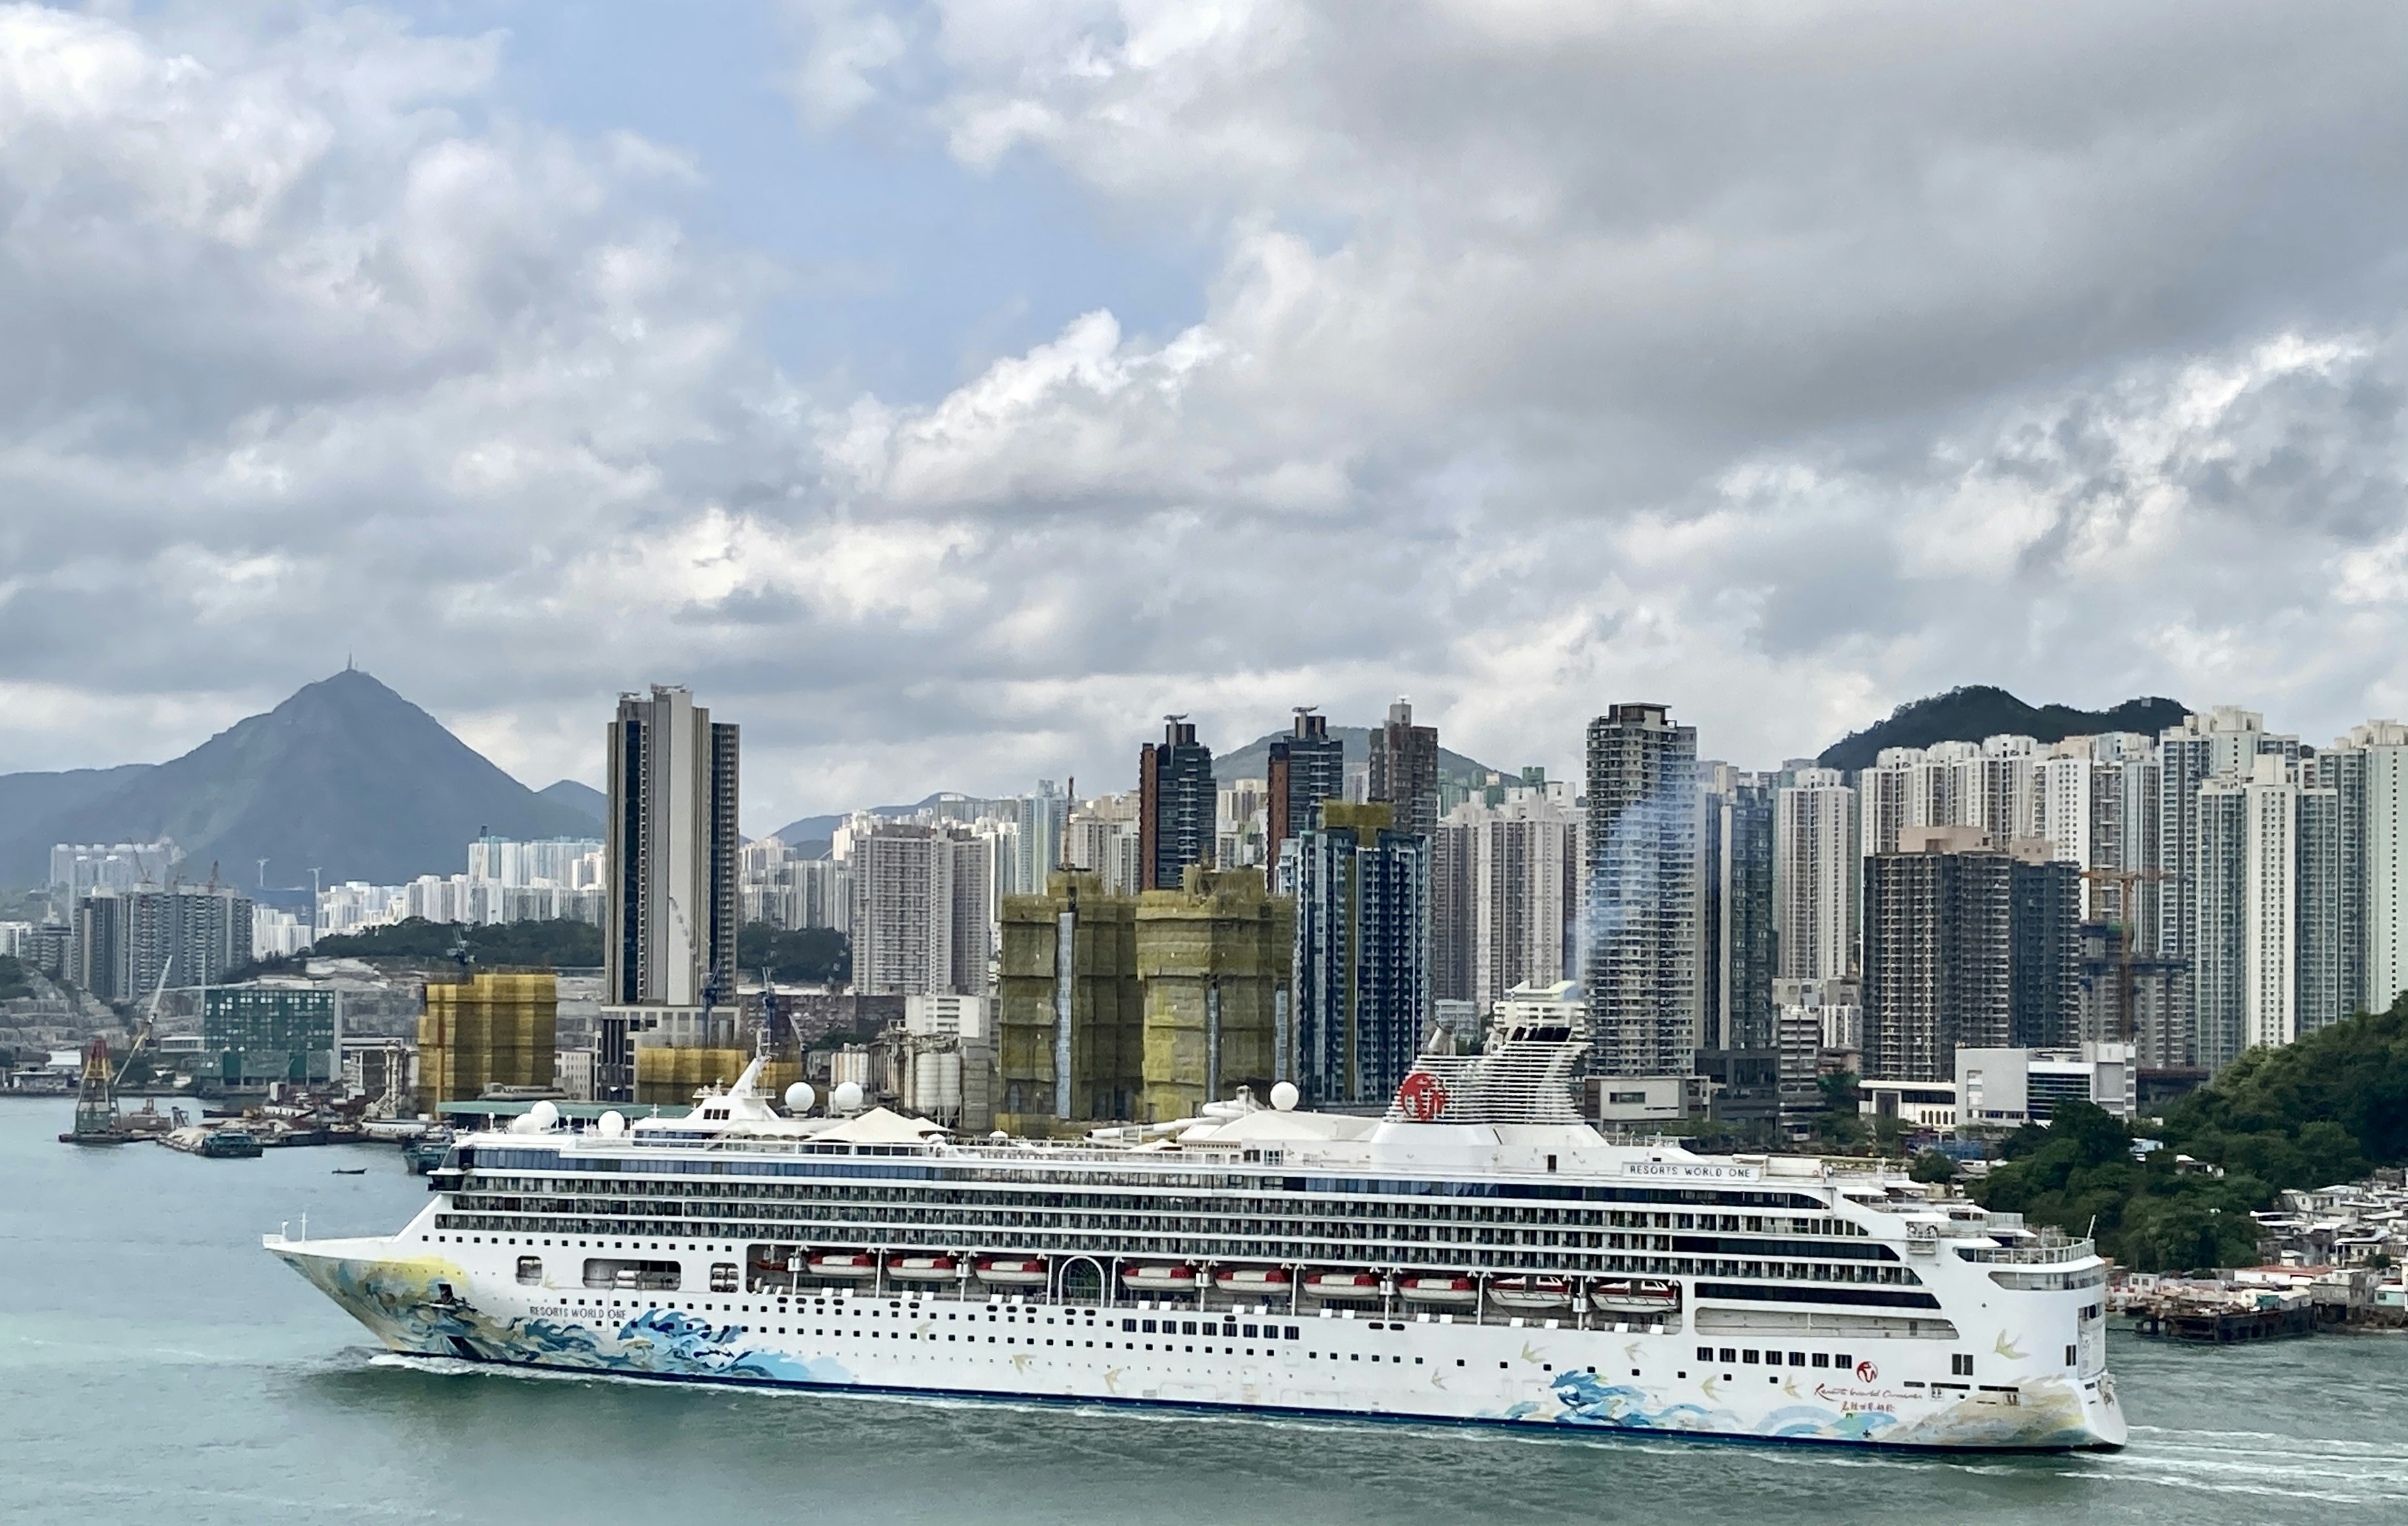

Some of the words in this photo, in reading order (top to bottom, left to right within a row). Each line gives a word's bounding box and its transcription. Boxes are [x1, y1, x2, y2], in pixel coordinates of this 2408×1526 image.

[1630, 1165, 1678, 1175] RESORTS
[1685, 1167, 1722, 1177] WORLD
[1729, 1169, 1750, 1178] ONE
[530, 1307, 568, 1317] RESORTS
[571, 1308, 604, 1318] WORLD
